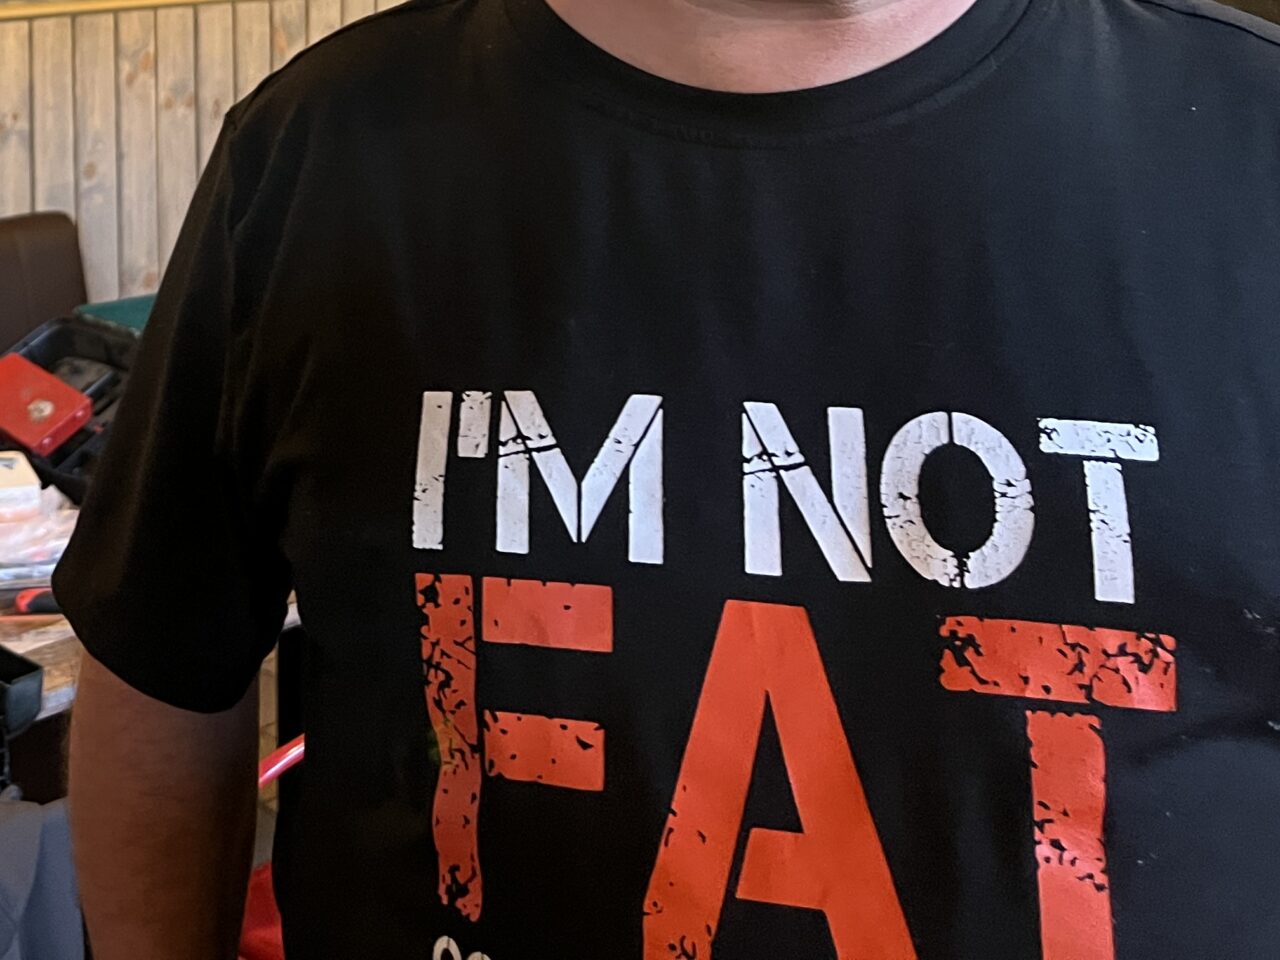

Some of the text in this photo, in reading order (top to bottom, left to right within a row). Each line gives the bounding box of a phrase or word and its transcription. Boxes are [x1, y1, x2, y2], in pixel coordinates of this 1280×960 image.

[412, 391, 1160, 604] I'M NOT
[414, 573, 1178, 960] FAT
